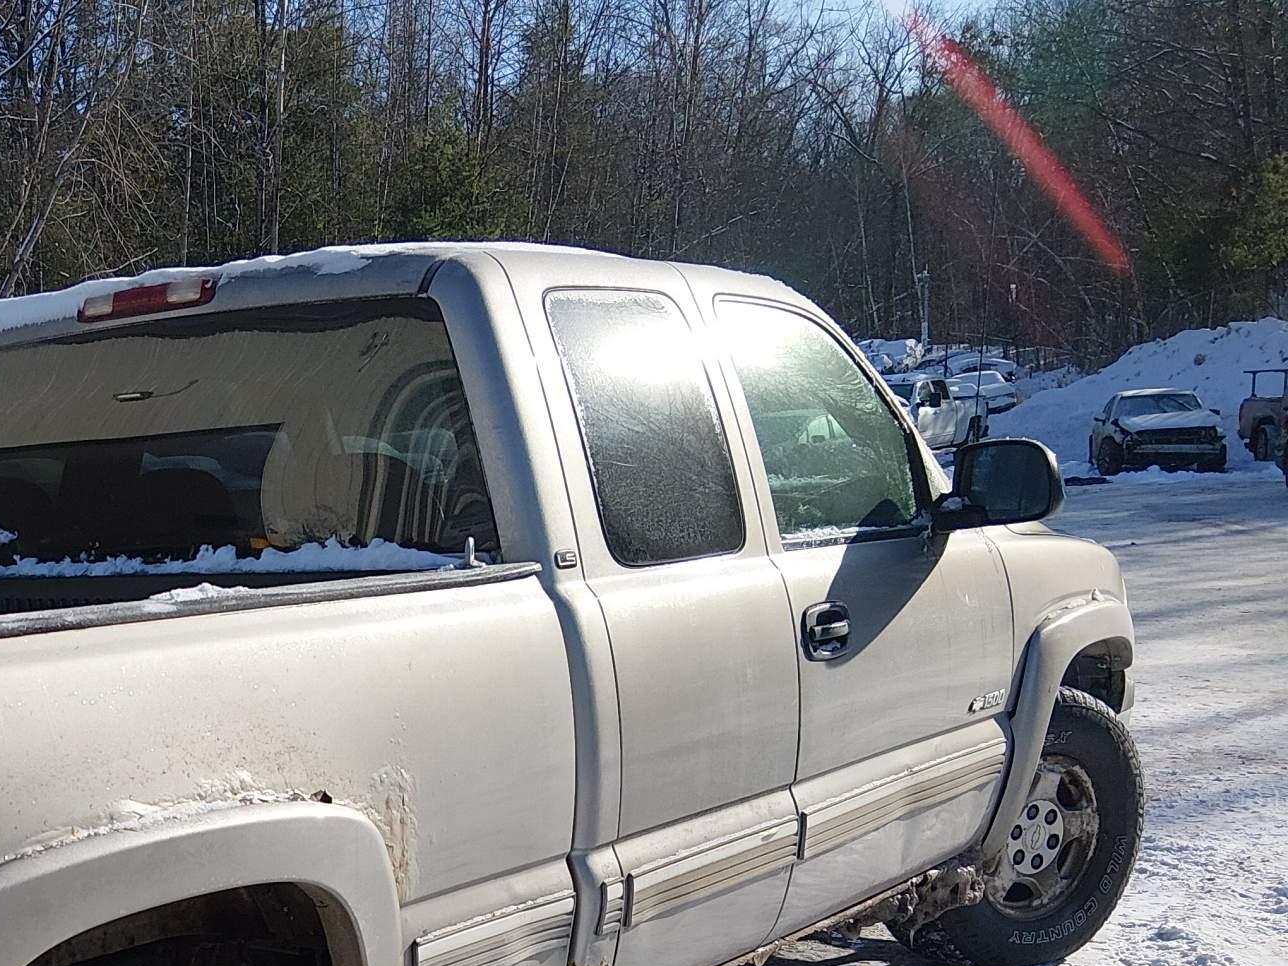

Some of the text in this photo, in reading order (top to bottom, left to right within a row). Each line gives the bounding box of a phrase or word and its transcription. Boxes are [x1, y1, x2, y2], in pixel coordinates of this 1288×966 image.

[555, 550, 578, 568] LS
[983, 688, 1006, 708] 1500
[1009, 835, 1128, 944] WILD COUNTRY
